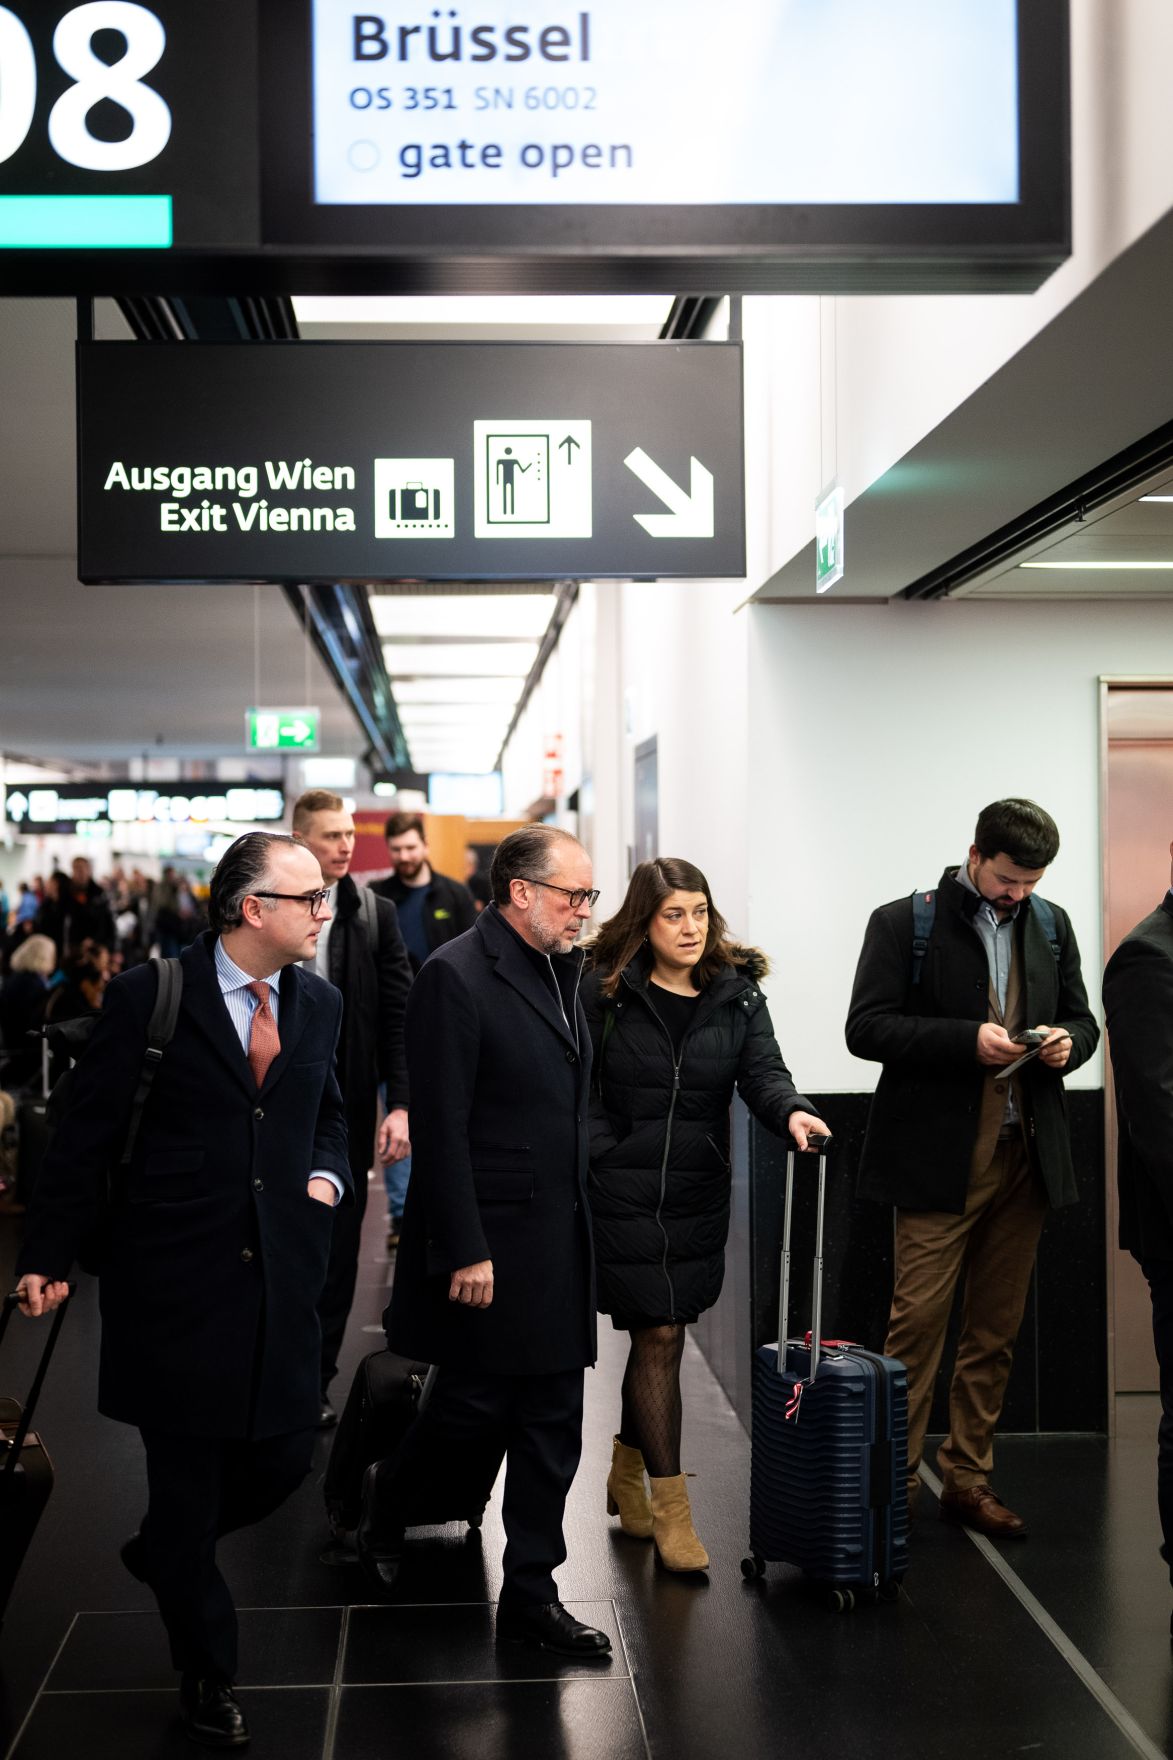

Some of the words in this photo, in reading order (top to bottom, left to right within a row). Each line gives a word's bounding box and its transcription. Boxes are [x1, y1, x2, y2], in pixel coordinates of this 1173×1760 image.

[352, 9, 590, 62] Brüssel
[349, 86, 393, 111] OS
[404, 86, 457, 111] 351
[474, 86, 514, 111] SN
[524, 86, 597, 111] 6002
[398, 139, 503, 179] gate
[519, 142, 632, 179] open
[103, 461, 259, 498] Ausgang
[263, 457, 356, 490] Wien
[160, 500, 227, 532] Exit
[231, 499, 357, 532] Vienna
